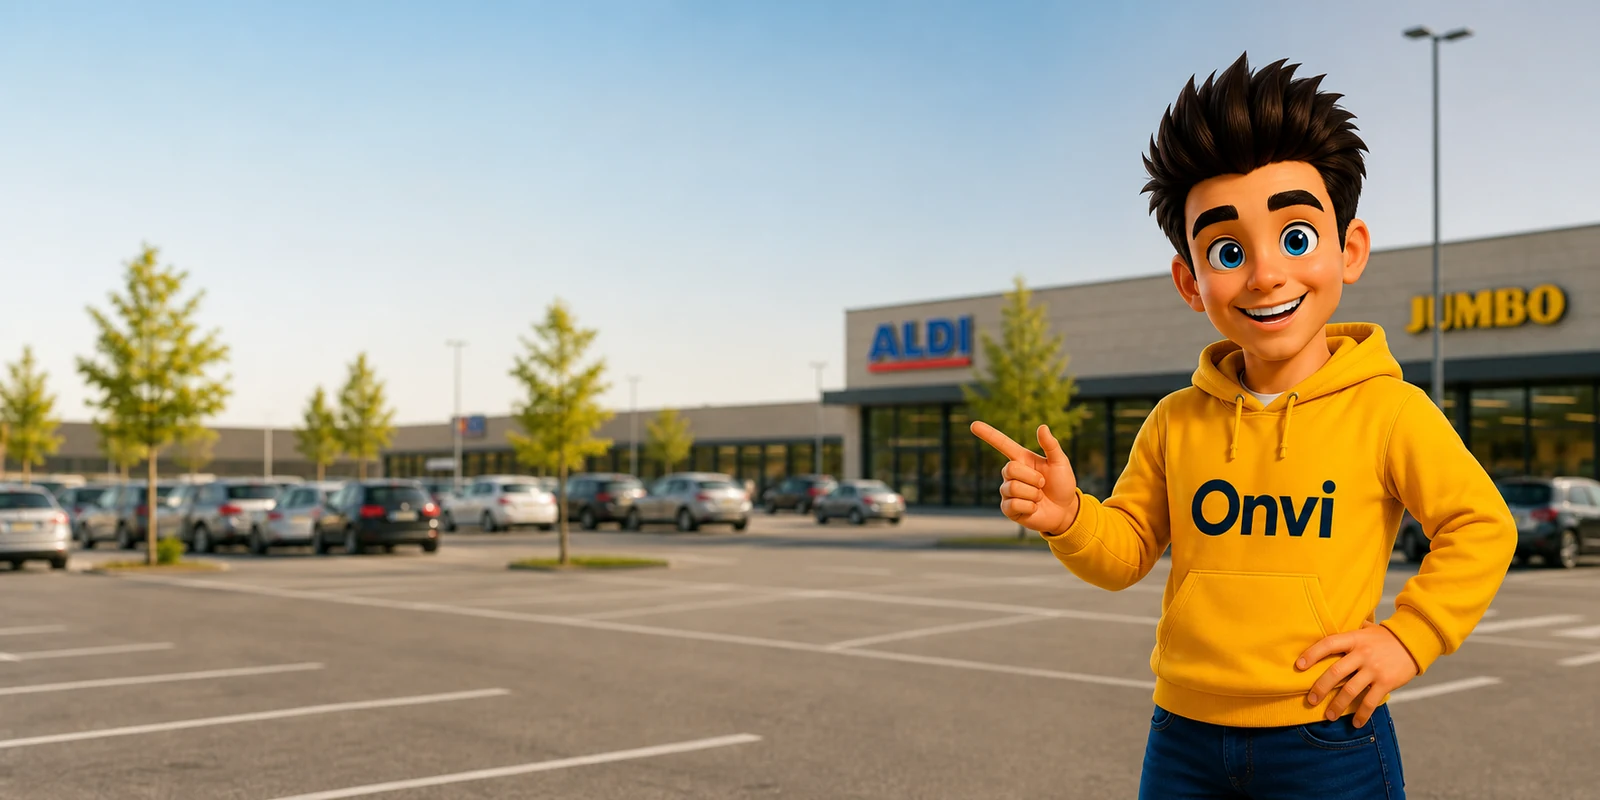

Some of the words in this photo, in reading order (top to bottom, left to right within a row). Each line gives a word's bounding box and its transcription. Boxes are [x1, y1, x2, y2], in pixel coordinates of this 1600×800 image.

[1406, 284, 1566, 333] JUMBO
[869, 316, 972, 361] ALDI
[1191, 479, 1336, 539] Onvi
